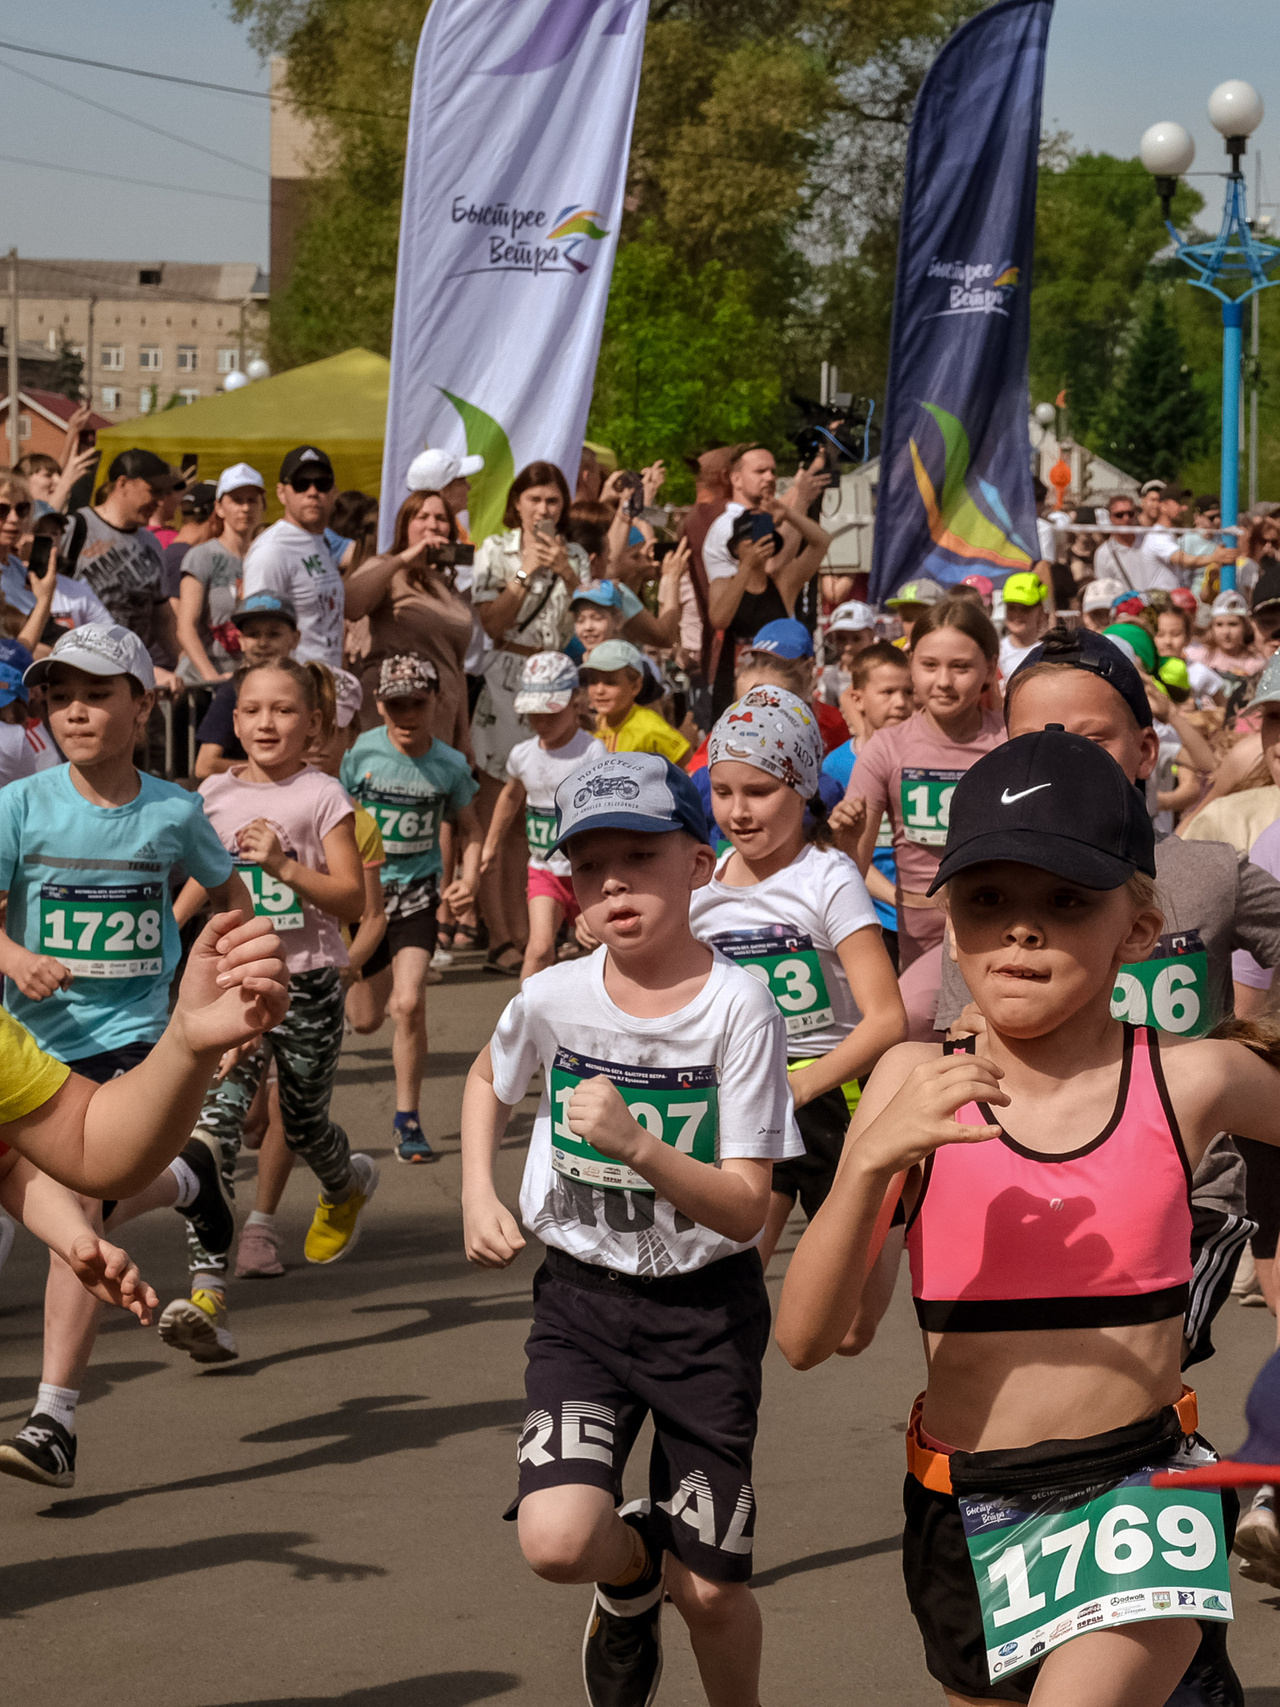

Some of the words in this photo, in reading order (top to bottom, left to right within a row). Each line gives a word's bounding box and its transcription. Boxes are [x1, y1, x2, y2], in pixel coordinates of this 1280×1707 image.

[451, 194, 548, 238] Быстрее
[488, 235, 560, 277] Ветра
[44, 909, 161, 952] 1728
[555, 1086, 708, 1153] 107
[987, 1503, 1217, 1628] 1769
